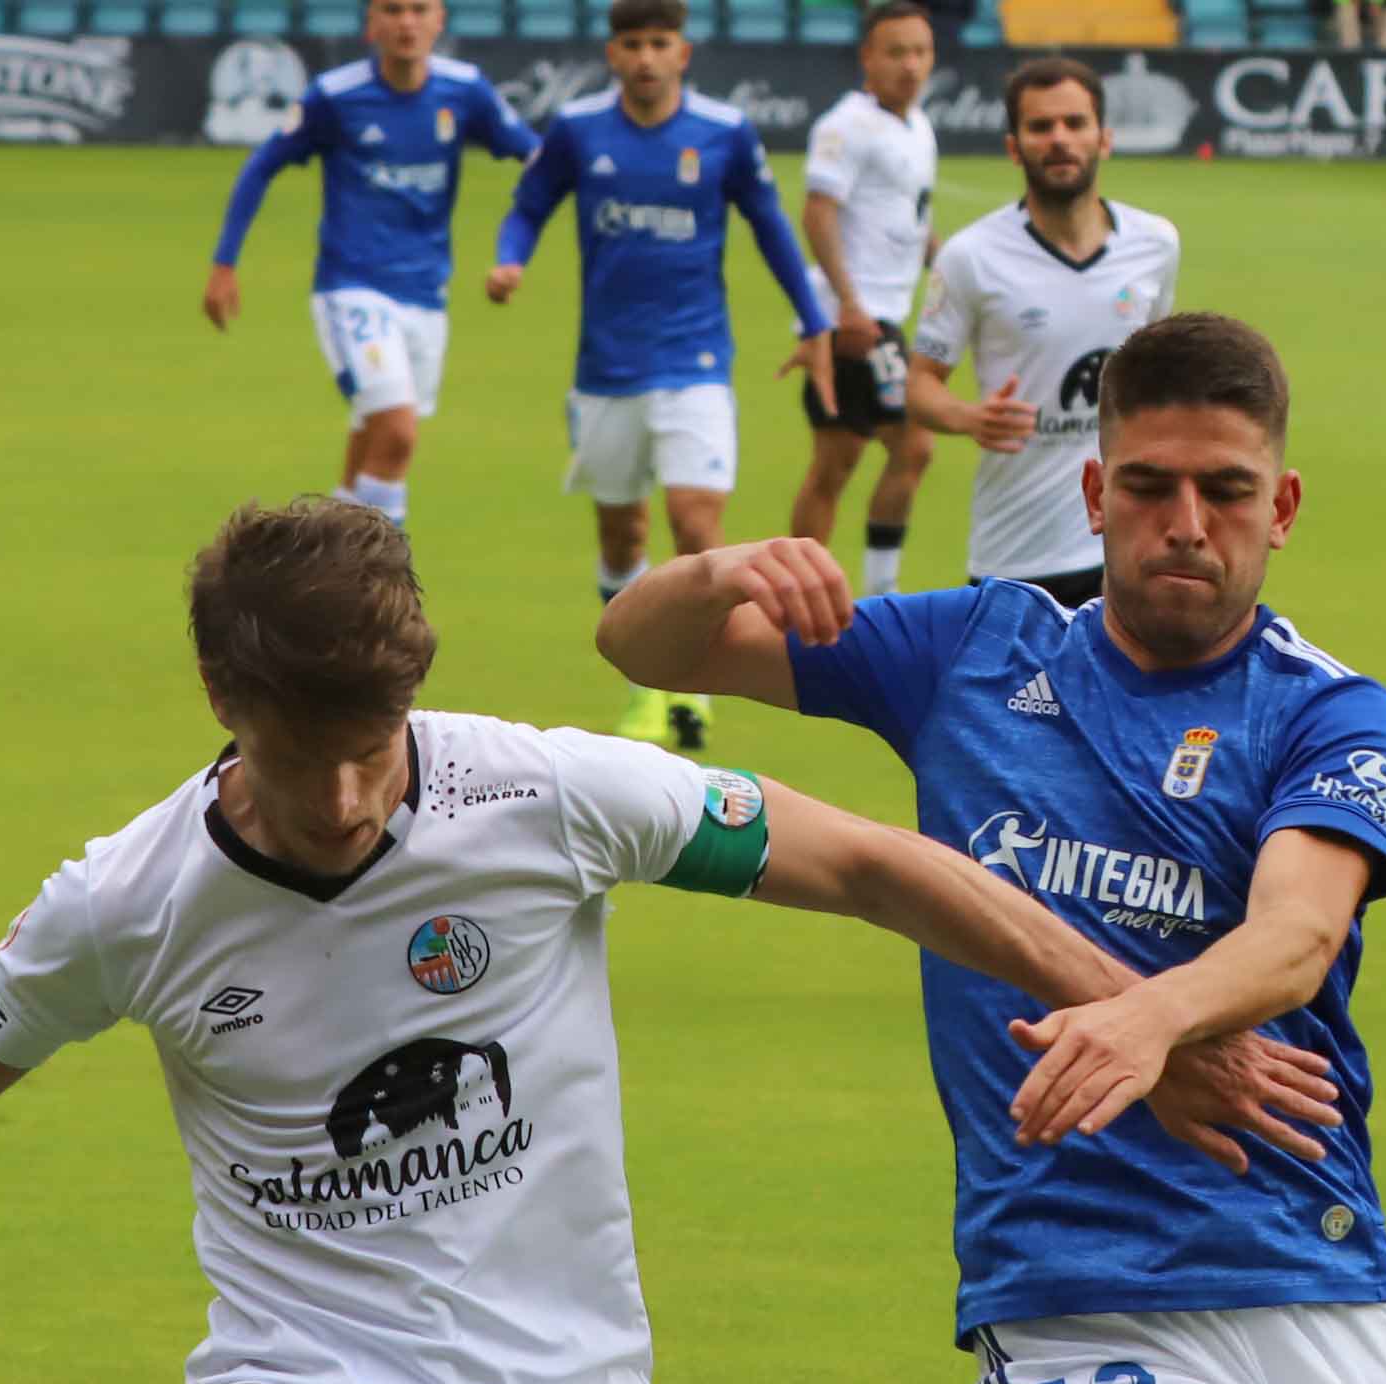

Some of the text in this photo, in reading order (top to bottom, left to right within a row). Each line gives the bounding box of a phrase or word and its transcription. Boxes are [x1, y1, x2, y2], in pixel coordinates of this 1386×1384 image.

[1007, 693, 1061, 716] adidas
[463, 788, 538, 806] CHARRA
[1038, 838, 1205, 921] INTEGRA
[211, 1014, 263, 1035] umbro
[229, 1117, 532, 1208] Salamanca
[366, 1202, 411, 1225] DEL
[416, 1166, 524, 1213] TALENTO
